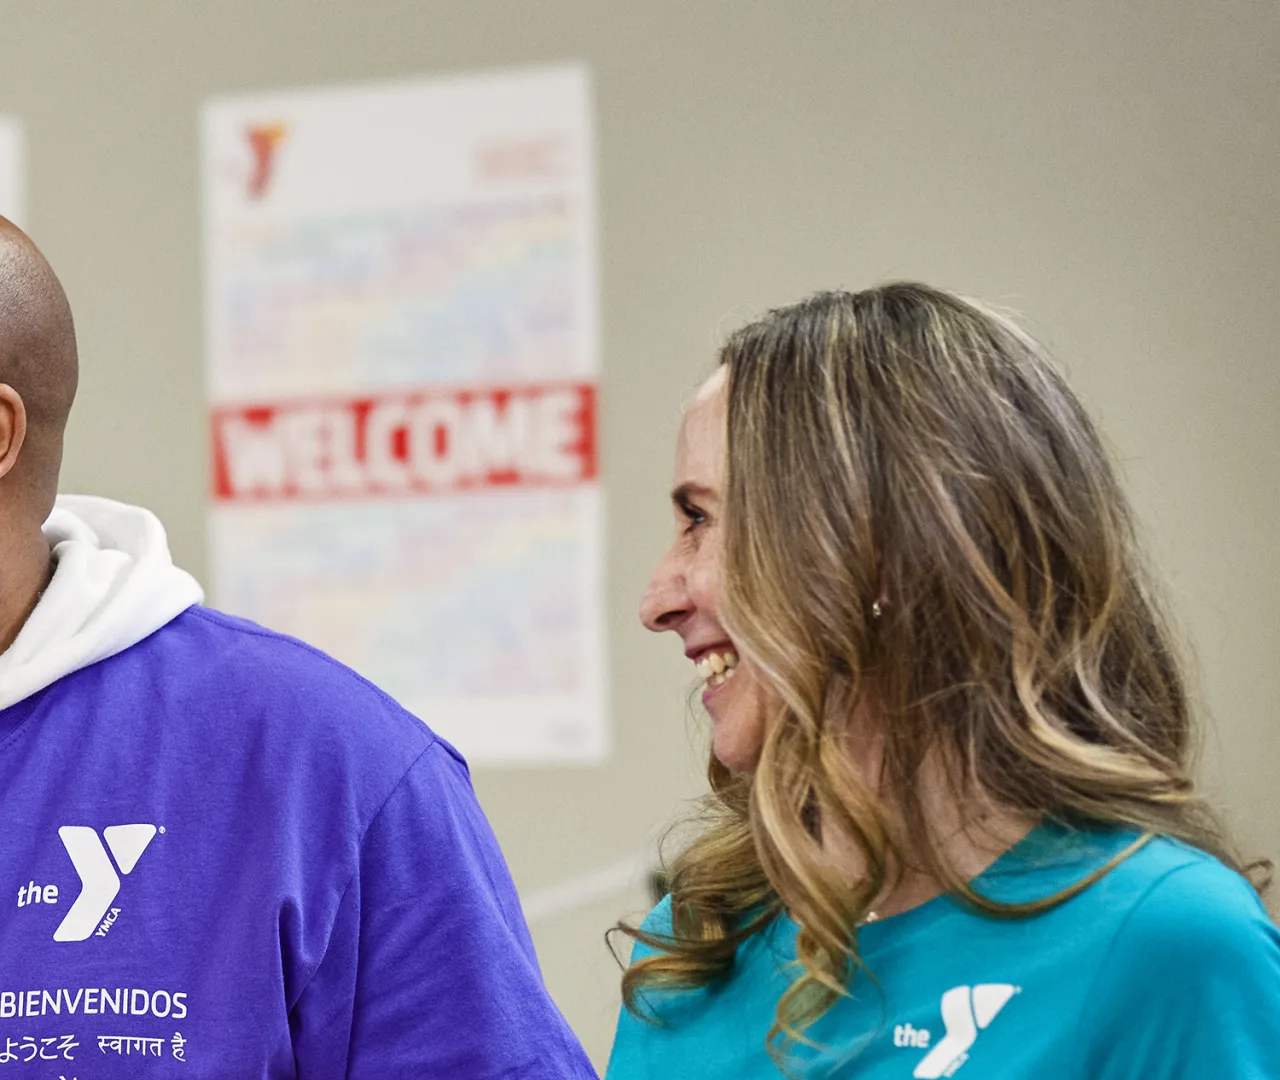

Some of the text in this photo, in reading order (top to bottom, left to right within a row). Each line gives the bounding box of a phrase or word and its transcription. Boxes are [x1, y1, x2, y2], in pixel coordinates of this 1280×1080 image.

[220, 389, 583, 492] WELCOME
[17, 880, 59, 908] the
[95, 907, 122, 938] YMCA
[0, 987, 188, 1019] BIENVENIDOS
[96, 1031, 187, 1062] स्वागत है
[893, 1022, 931, 1049] the
